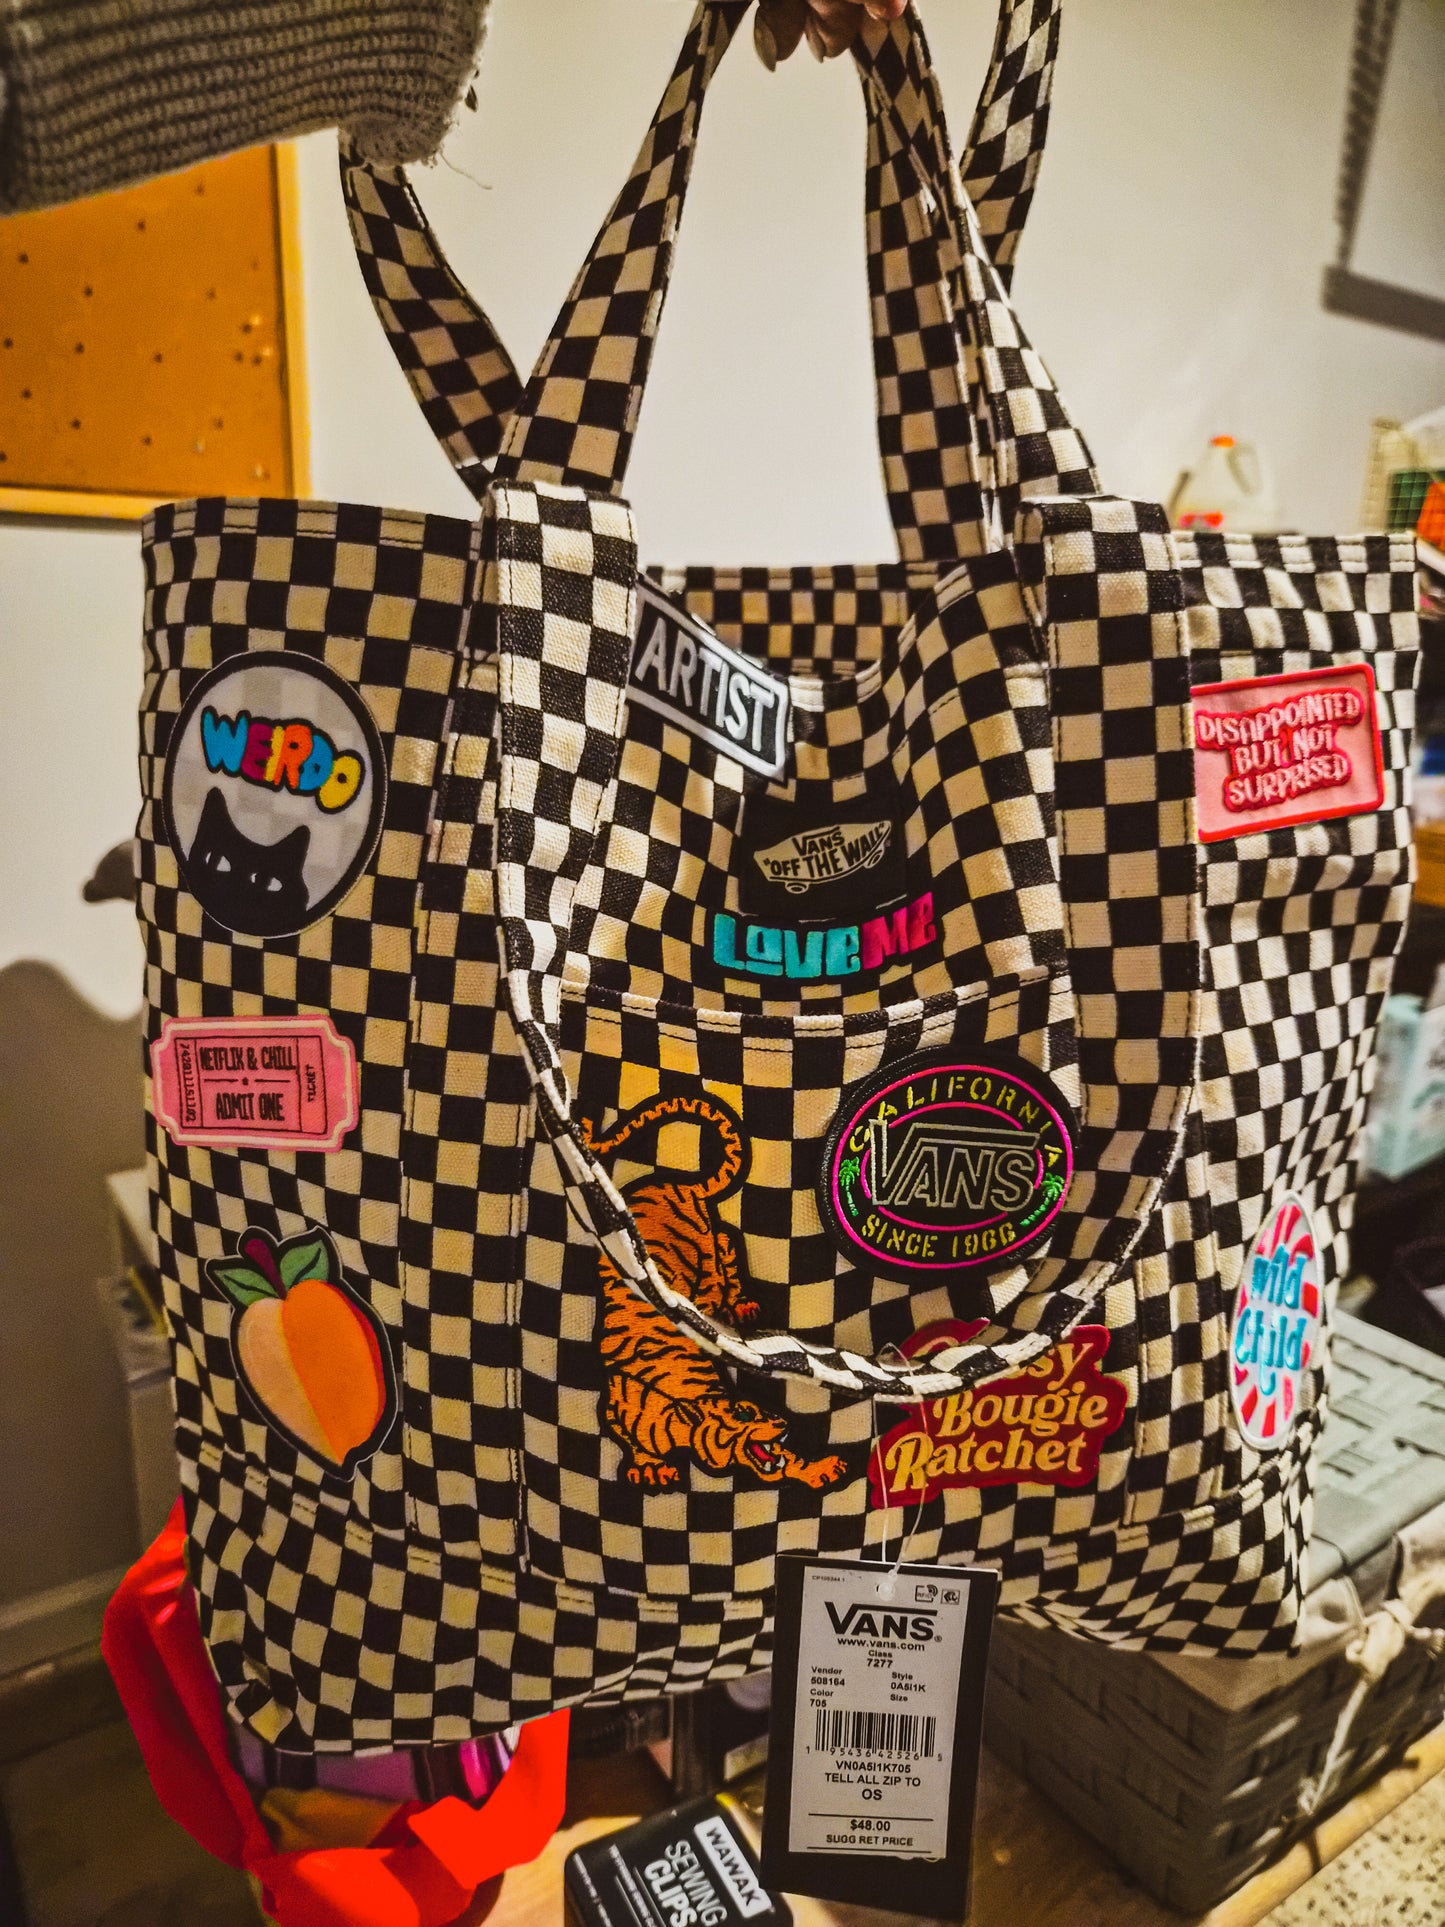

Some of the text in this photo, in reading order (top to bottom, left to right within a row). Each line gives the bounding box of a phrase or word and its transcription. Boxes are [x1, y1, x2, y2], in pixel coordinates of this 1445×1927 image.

[634, 617, 775, 752] ARTIST
[1198, 691, 1361, 747] DISAPPOINTED
[202, 707, 363, 811] WEIRDO
[1234, 723, 1333, 775] BUT NOT
[1228, 753, 1349, 806] SURPRISED
[791, 825, 846, 857] VANS
[802, 847, 845, 879] THE
[861, 891, 937, 970] ME
[199, 1045, 299, 1072] NETFLIX & CHILL
[215, 1092, 285, 1121] ADMIT ONE
[849, 1076, 1064, 1167] CALIFORNIA
[868, 1118, 1042, 1212] VANS
[861, 1214, 1017, 1258] SINCE 1966
[1250, 1243, 1307, 1310] wild
[932, 1380, 1109, 1438] Bougie
[885, 1428, 1087, 1493] Ratchet
[837, 1637, 925, 1652] www.vans.com
[868, 1649, 893, 1659] Class
[811, 1666, 843, 1675] Vendor
[867, 1658, 894, 1669] 7277
[891, 1671, 914, 1681] Style
[810, 1676, 846, 1687] 508164
[810, 1688, 835, 1697] Color
[890, 1693, 909, 1702] Size
[809, 1698, 827, 1708] 705
[805, 1746, 811, 1754] 1
[829, 1747, 872, 1758] 95436
[878, 1750, 920, 1761] 42526
[824, 1773, 921, 1787] TELL ALL ZIP TO
[861, 1788, 883, 1801] OS
[826, 1834, 914, 1847] SUGG RET PRICE
[850, 1818, 891, 1832] $48.00
[705, 1826, 761, 1907] WAWAK
[643, 1859, 698, 1927] CLIPS
[664, 1839, 728, 1927] SEWING
